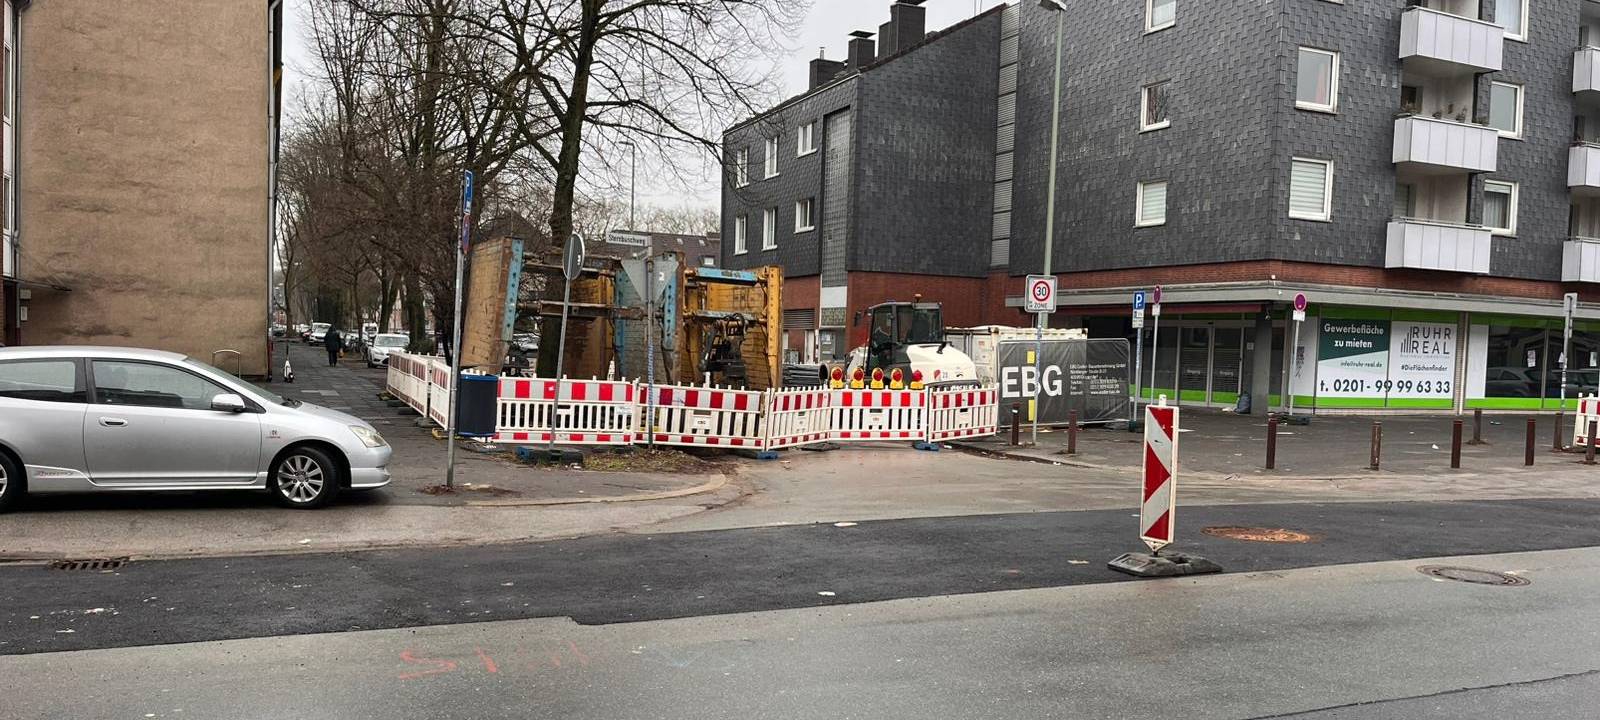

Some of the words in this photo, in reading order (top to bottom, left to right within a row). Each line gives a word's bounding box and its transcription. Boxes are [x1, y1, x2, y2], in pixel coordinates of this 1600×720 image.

[1036, 286, 1047, 296] 30
[1135, 294, 1143, 308] P
[1324, 323, 1384, 335] Gewerbefläche
[1412, 326, 1451, 340] RUHR
[1345, 338, 1373, 349] mieten
[1411, 341, 1450, 355] REAL
[1002, 365, 1063, 398] EBG
[1320, 379, 1329, 392] t.
[1375, 380, 1393, 392] 99
[1397, 380, 1412, 392] 99
[1416, 380, 1431, 393] 63
[1435, 381, 1450, 393] 33
